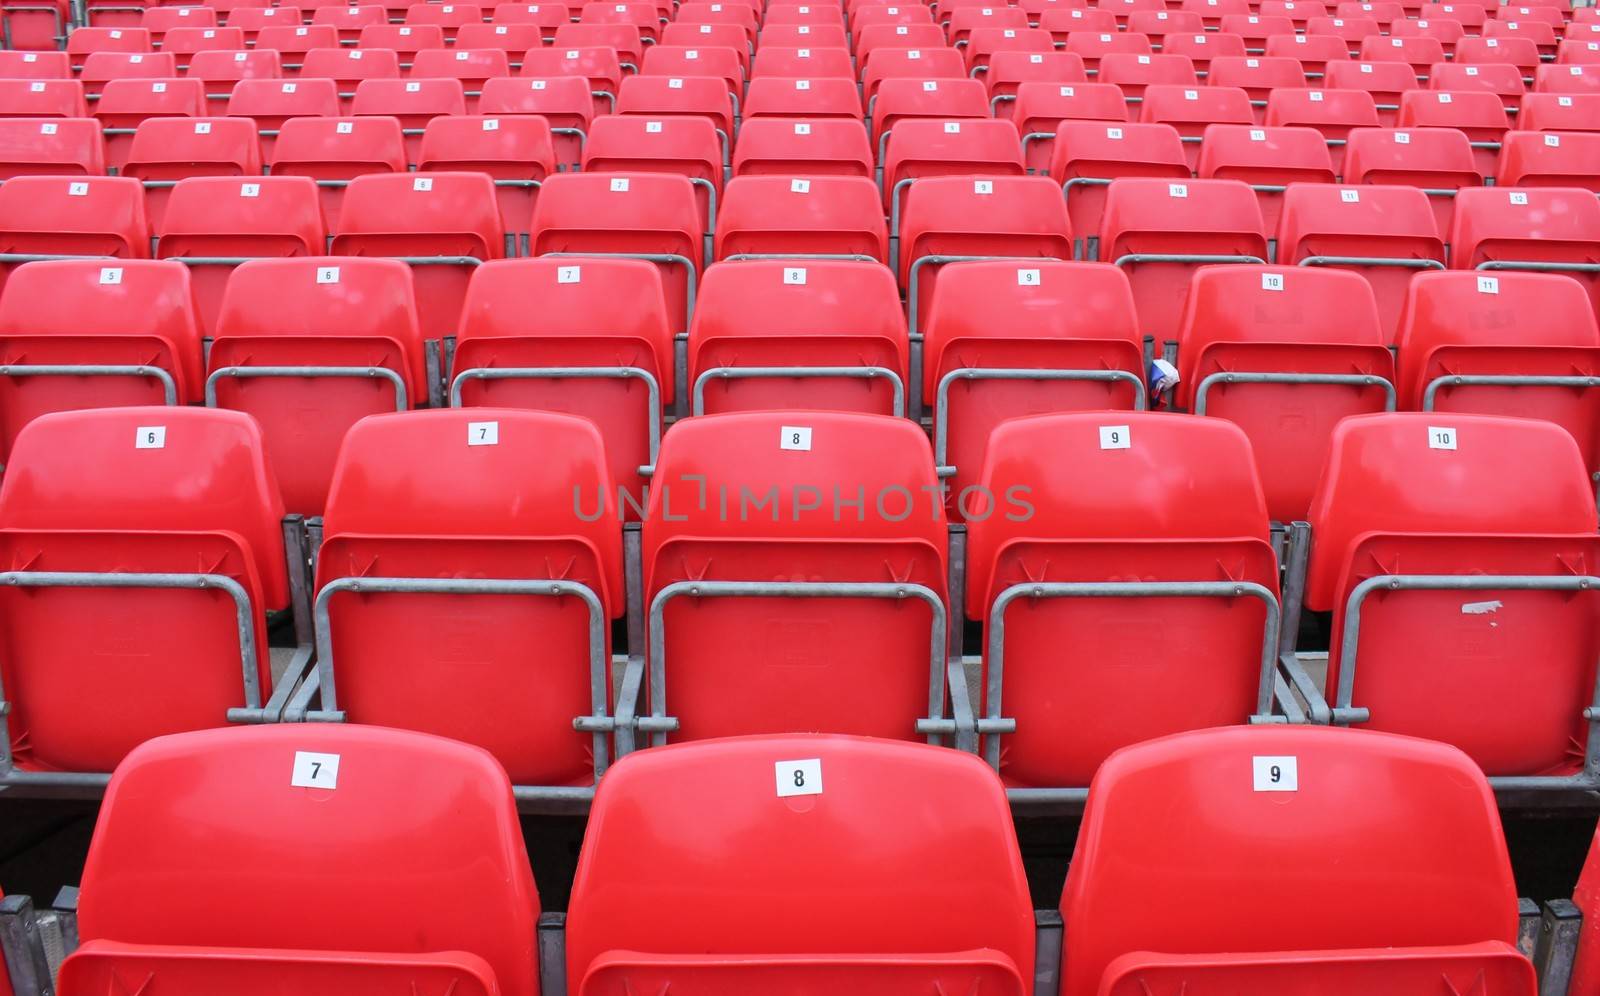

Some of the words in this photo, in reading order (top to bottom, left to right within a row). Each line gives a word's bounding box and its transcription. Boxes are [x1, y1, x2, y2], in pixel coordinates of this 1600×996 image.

[247, 186, 253, 194] 5
[420, 181, 426, 189] 6
[617, 181, 623, 189] 7
[980, 184, 987, 192] 9
[108, 271, 114, 281] 5
[325, 271, 332, 280] 6
[566, 270, 572, 280] 7
[792, 271, 798, 281] 8
[1026, 273, 1033, 282] 9
[1268, 278, 1279, 287] 10
[1483, 281, 1493, 289] 11
[148, 432, 155, 444] 6
[479, 428, 487, 440] 7
[792, 432, 800, 445] 8
[1111, 431, 1120, 444] 9
[1436, 432, 1450, 445] 10
[311, 762, 322, 780] 7
[1270, 765, 1281, 783] 9
[793, 769, 805, 788] 8
